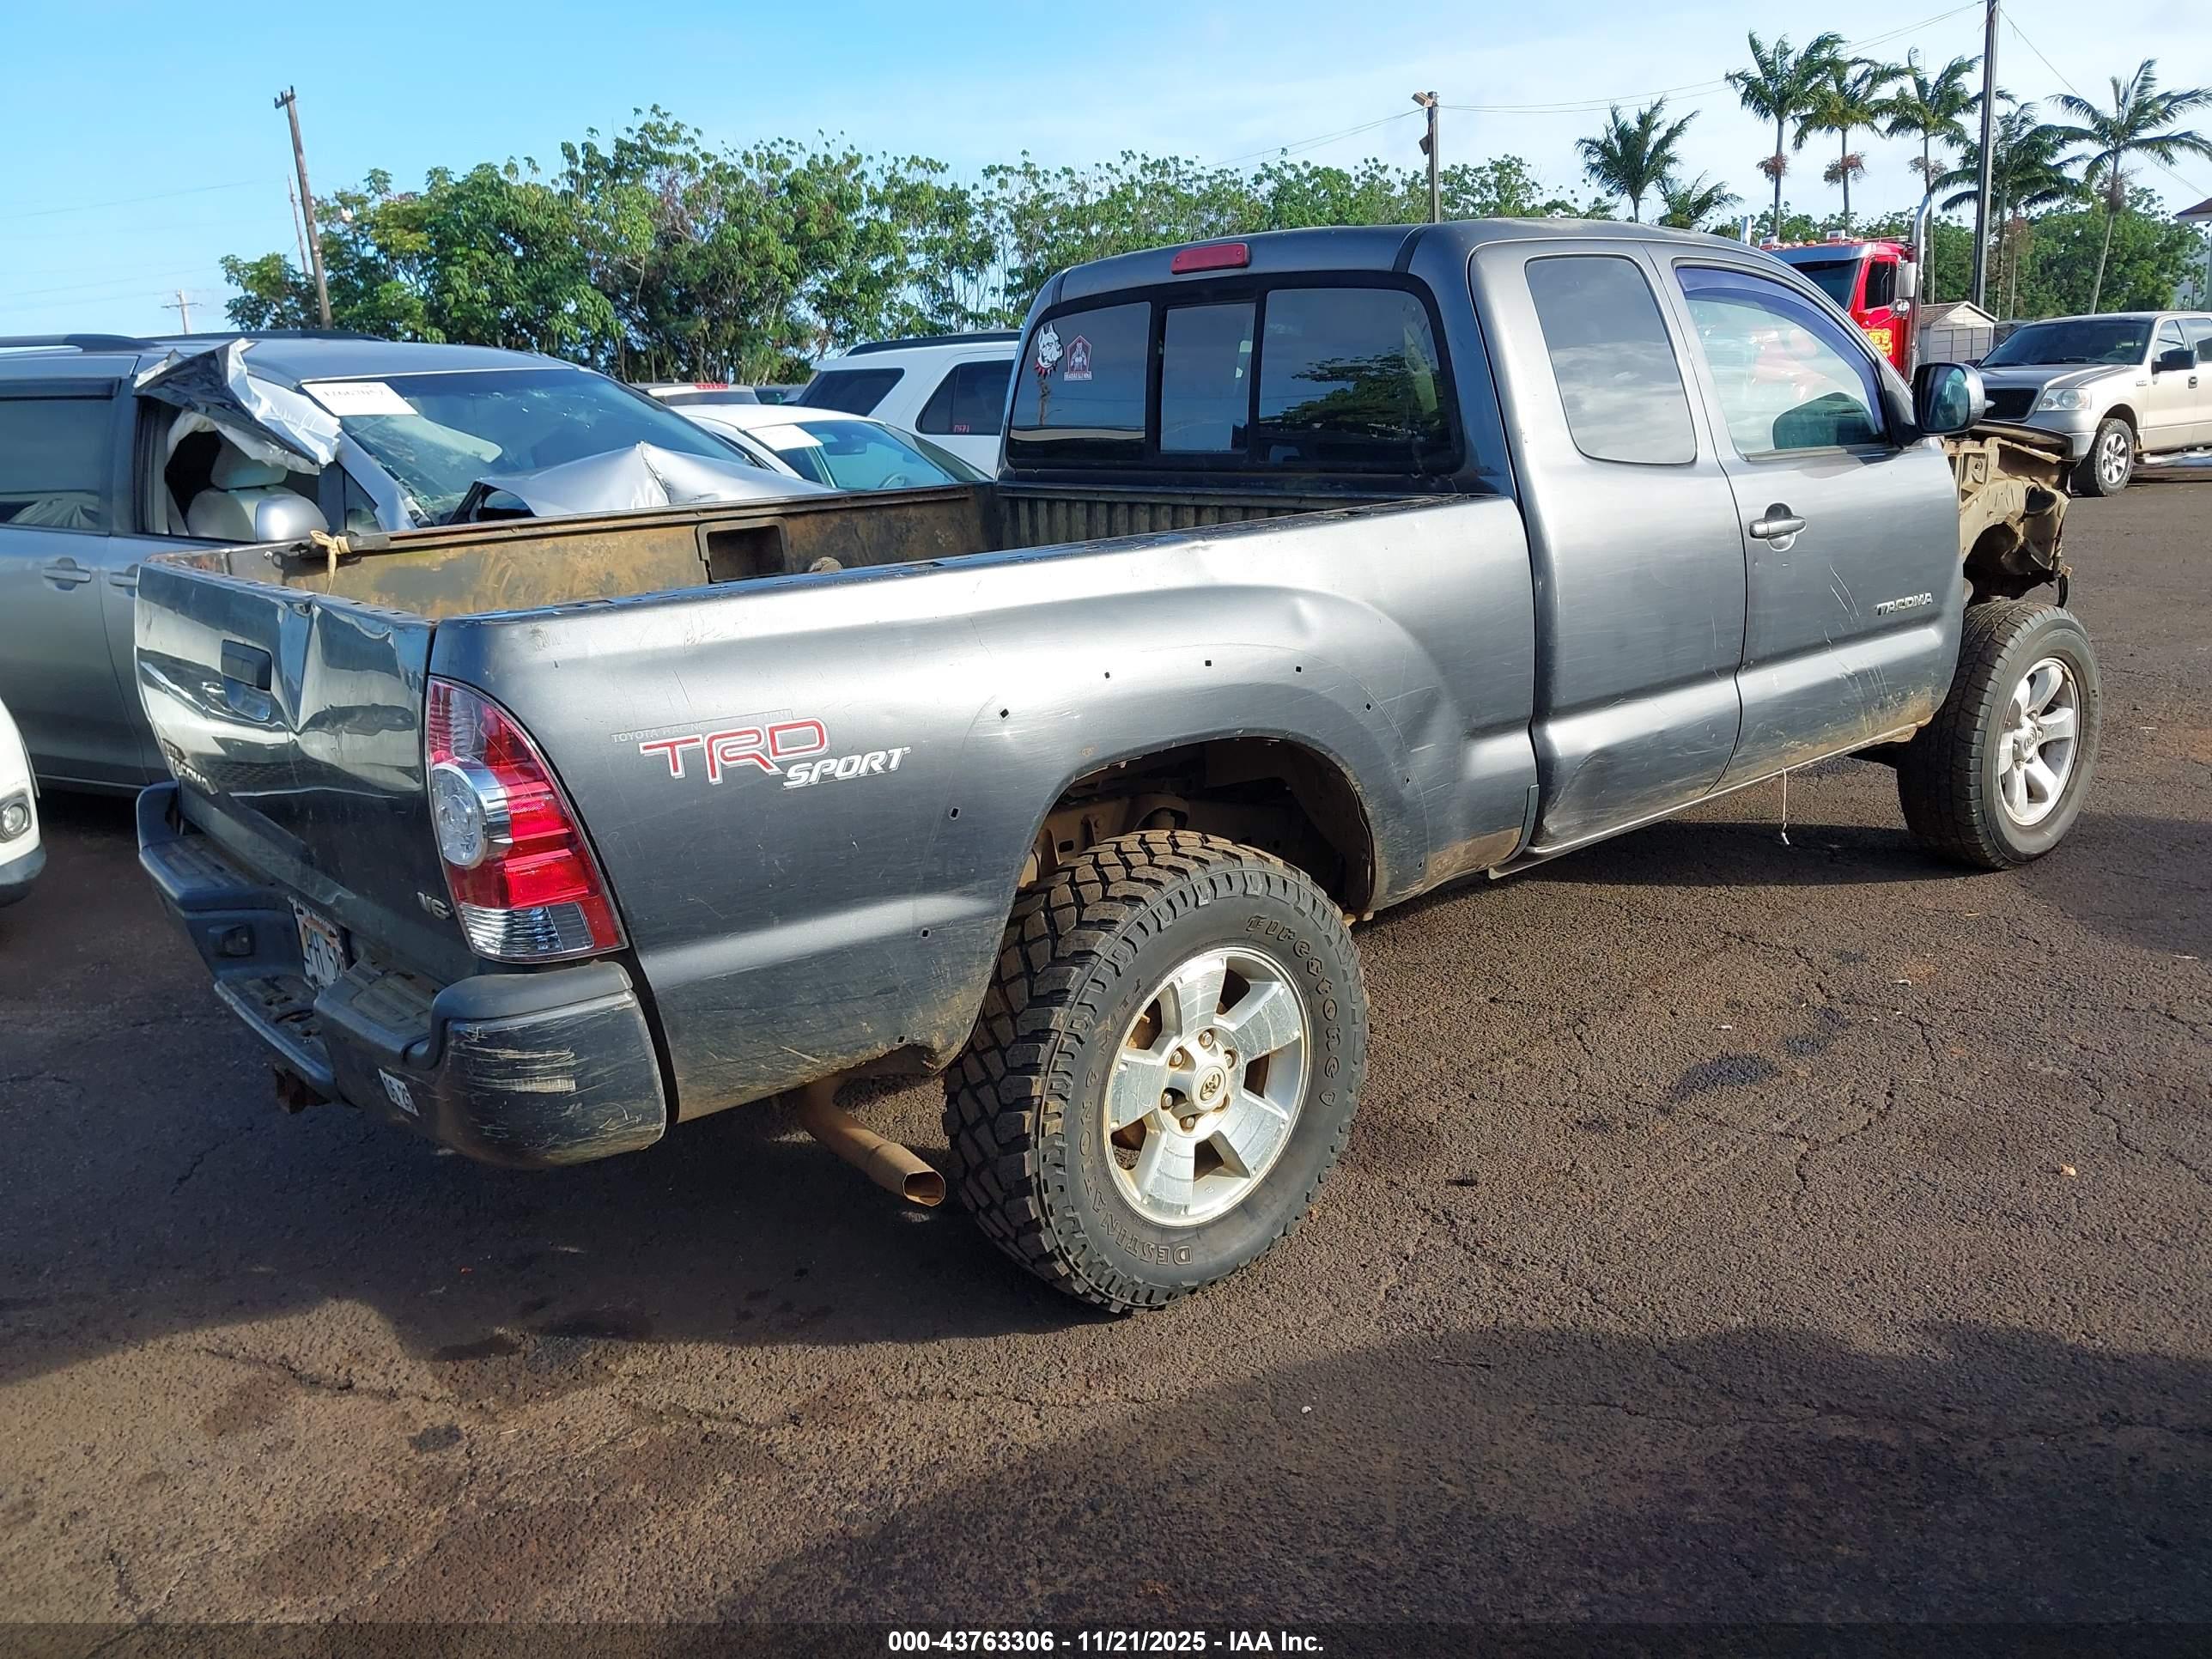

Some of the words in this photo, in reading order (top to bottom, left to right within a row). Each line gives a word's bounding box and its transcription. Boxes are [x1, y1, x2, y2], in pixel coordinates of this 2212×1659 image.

[1875, 592, 1933, 617] TACOMA
[611, 730, 660, 744] TOYOTA
[640, 717, 830, 786] TRD
[783, 746, 912, 791] SPORT
[416, 890, 451, 921] V6
